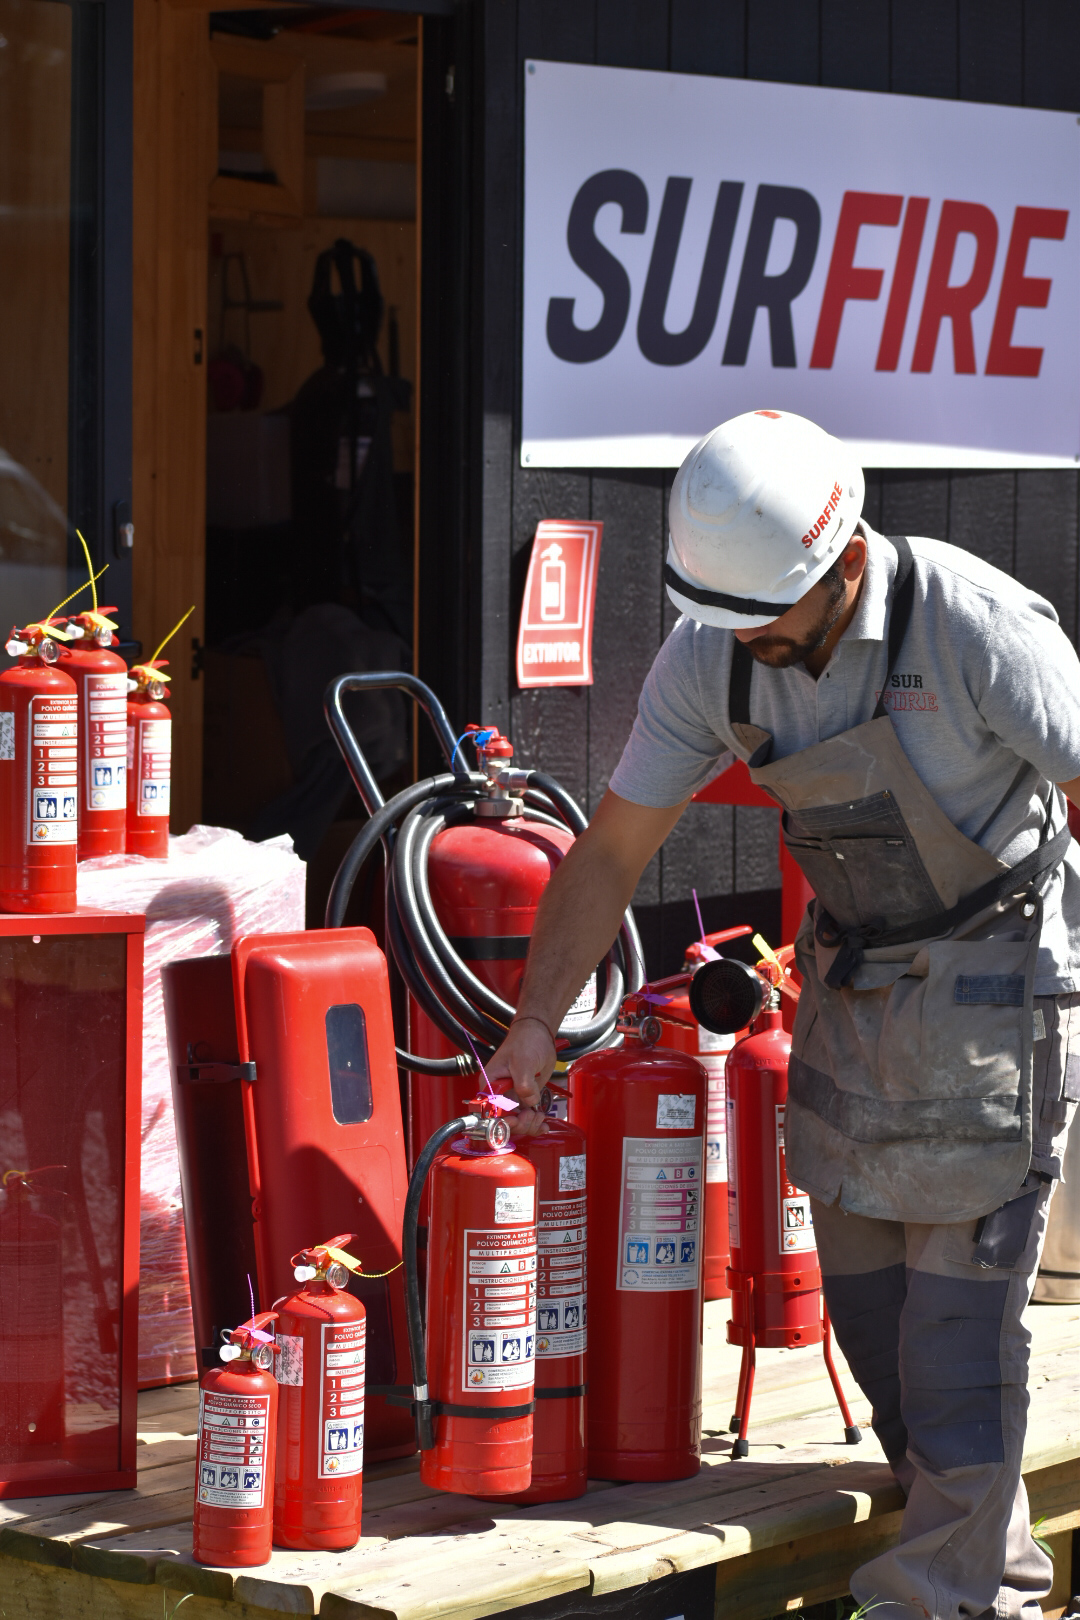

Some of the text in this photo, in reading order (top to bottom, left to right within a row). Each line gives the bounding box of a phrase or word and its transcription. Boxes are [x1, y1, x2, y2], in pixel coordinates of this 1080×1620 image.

[546, 169, 1070, 378] SURFIRE
[801, 481, 843, 549] SURFIRE
[523, 642, 581, 664] EXTINTOR
[891, 674, 923, 688] SUR
[875, 691, 939, 712] FIRE
[95, 722, 99, 731] 1
[94, 736, 101, 744] 2
[39, 749, 43, 758] 1
[94, 748, 101, 757] 3
[38, 762, 45, 771] 2
[38, 776, 45, 785] 3
[787, 1186, 794, 1195] 3
[631, 1192, 636, 1202] 1
[629, 1206, 637, 1216] 2
[629, 1220, 636, 1230] 3
[540, 1258, 545, 1267] 1
[539, 1272, 546, 1281] 2
[474, 1288, 479, 1297] 1
[539, 1286, 546, 1296] 3
[473, 1302, 480, 1311] 2
[473, 1317, 480, 1326] 3
[331, 1379, 336, 1388] 1
[329, 1393, 336, 1403] 2
[329, 1407, 336, 1417] 3
[205, 1431, 208, 1439] 1
[203, 1452, 208, 1460] 3
